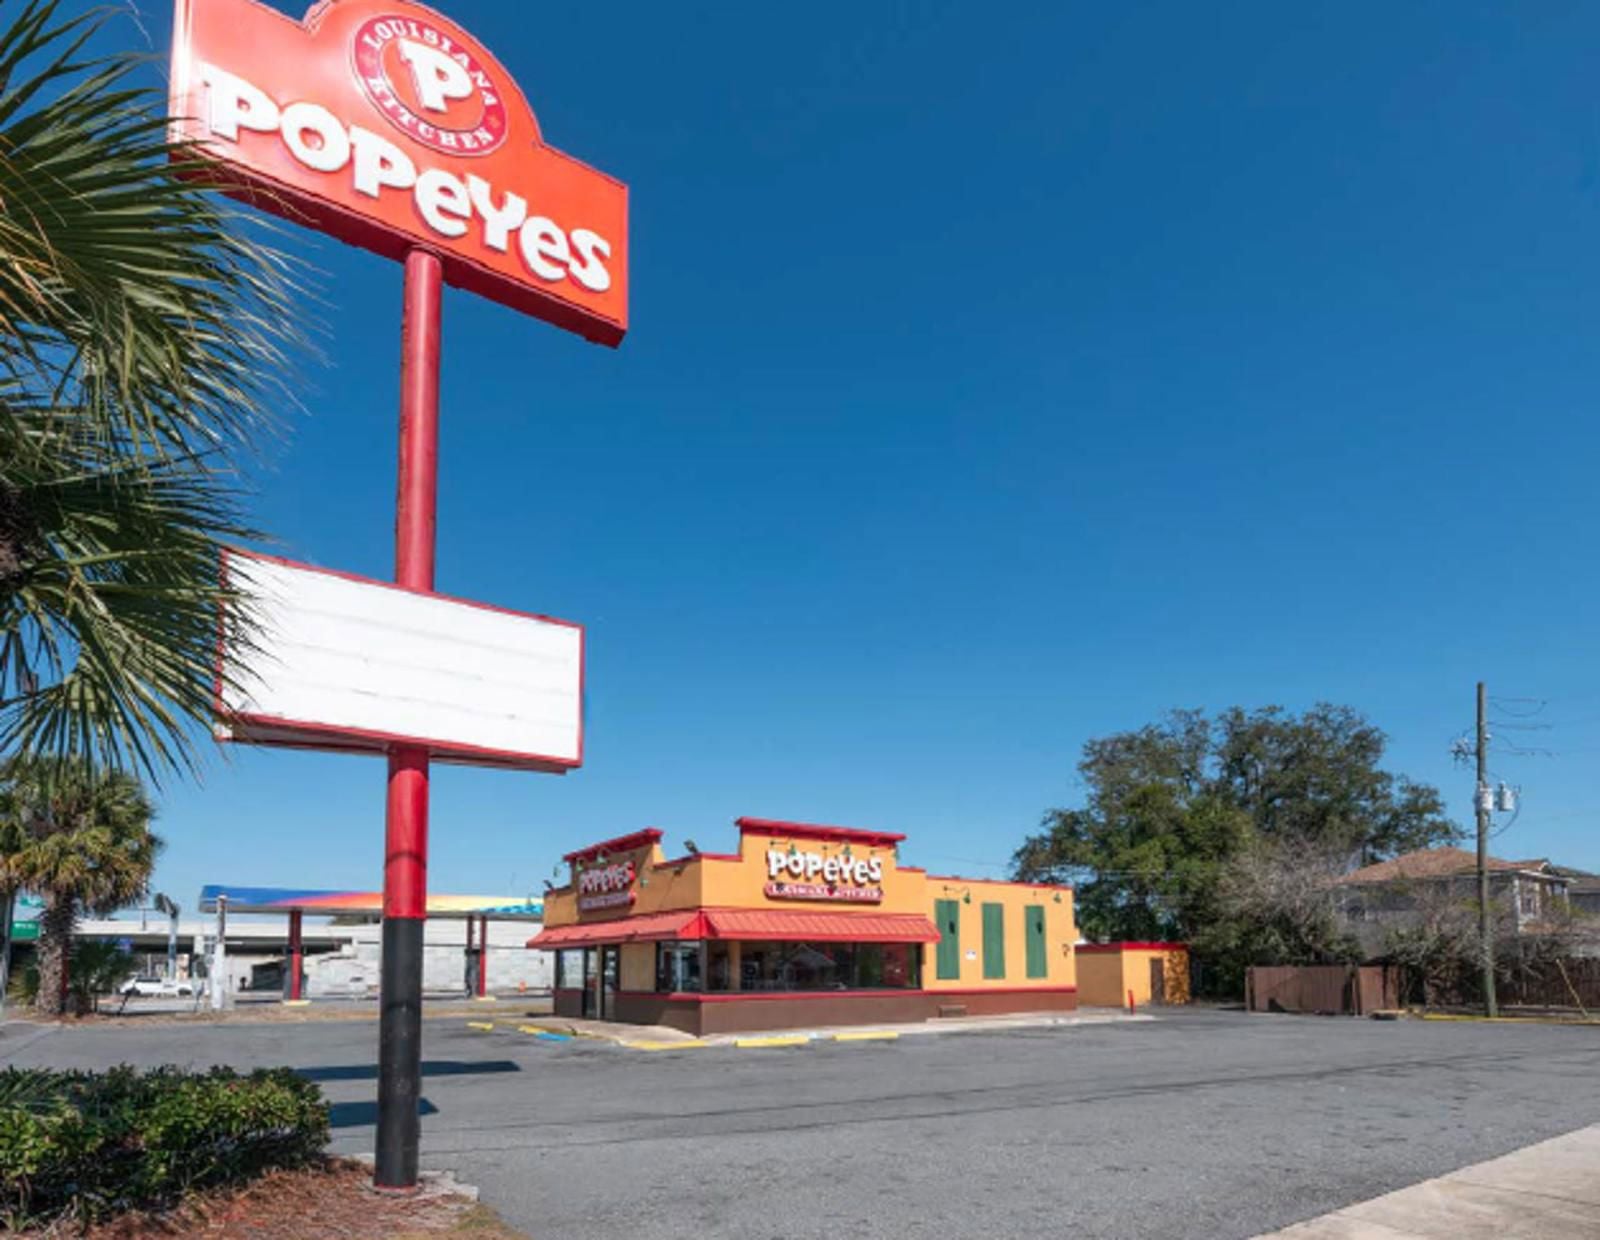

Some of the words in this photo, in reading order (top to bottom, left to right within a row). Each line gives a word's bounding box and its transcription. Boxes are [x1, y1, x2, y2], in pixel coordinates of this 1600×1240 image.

[362, 19, 498, 106] LOUISIANA
[399, 36, 474, 113] P
[367, 77, 495, 149] KITCHEN
